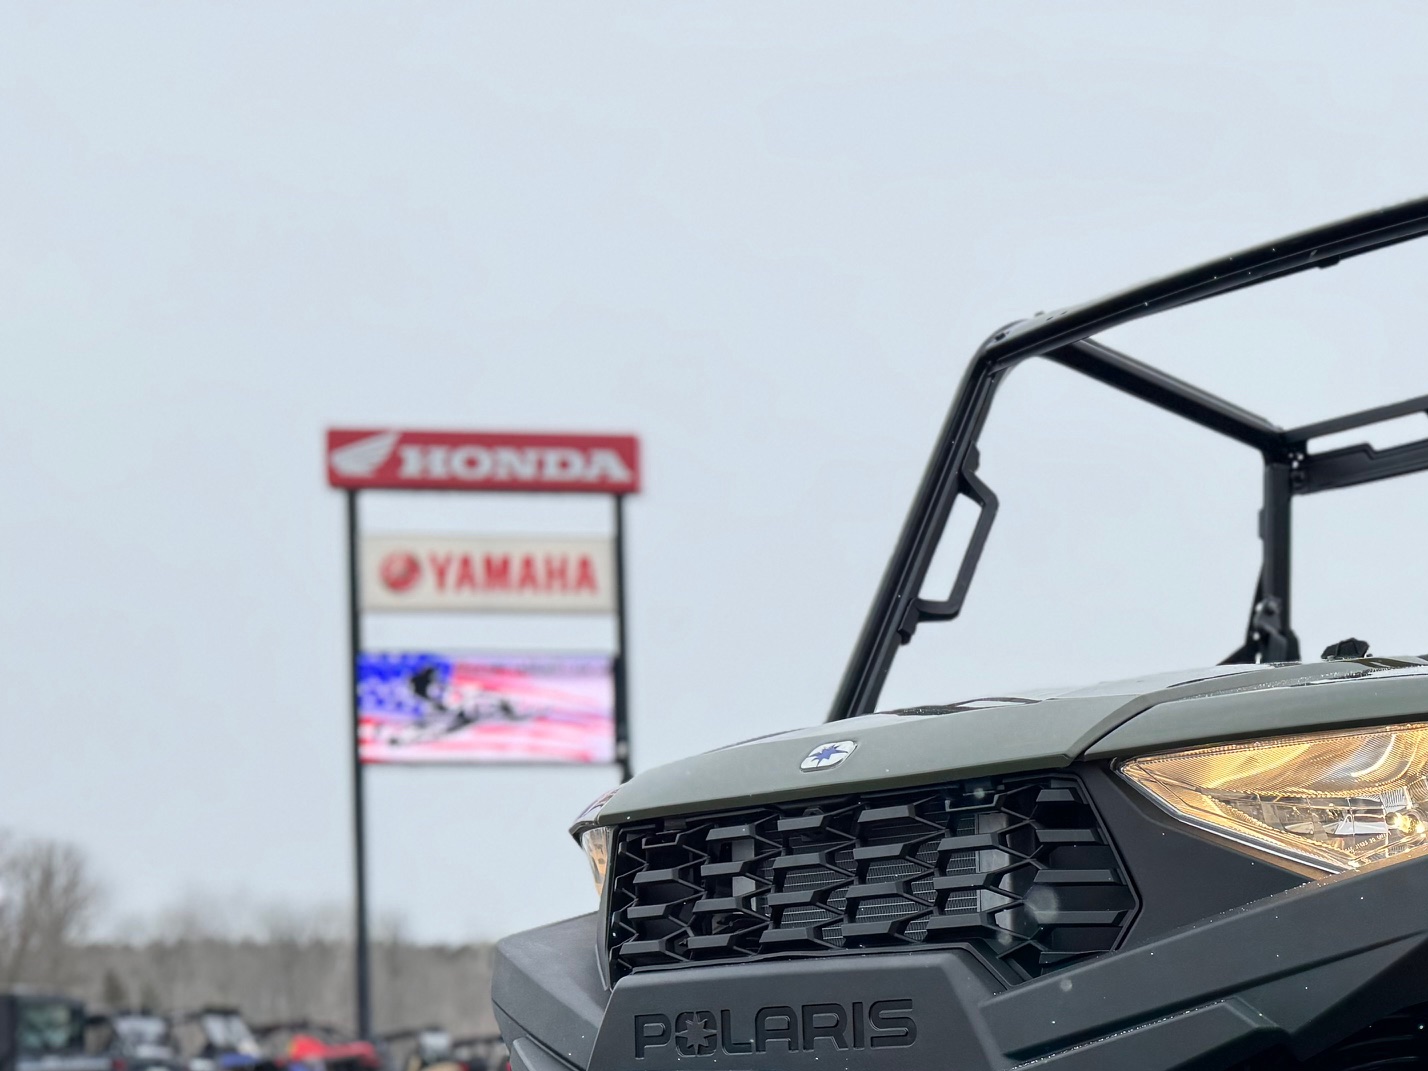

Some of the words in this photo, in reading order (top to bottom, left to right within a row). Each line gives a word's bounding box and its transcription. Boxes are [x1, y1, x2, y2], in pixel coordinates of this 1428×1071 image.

[399, 444, 632, 484] HONDA
[429, 552, 597, 594] YAMAHA
[634, 999, 917, 1060] POLARIS
